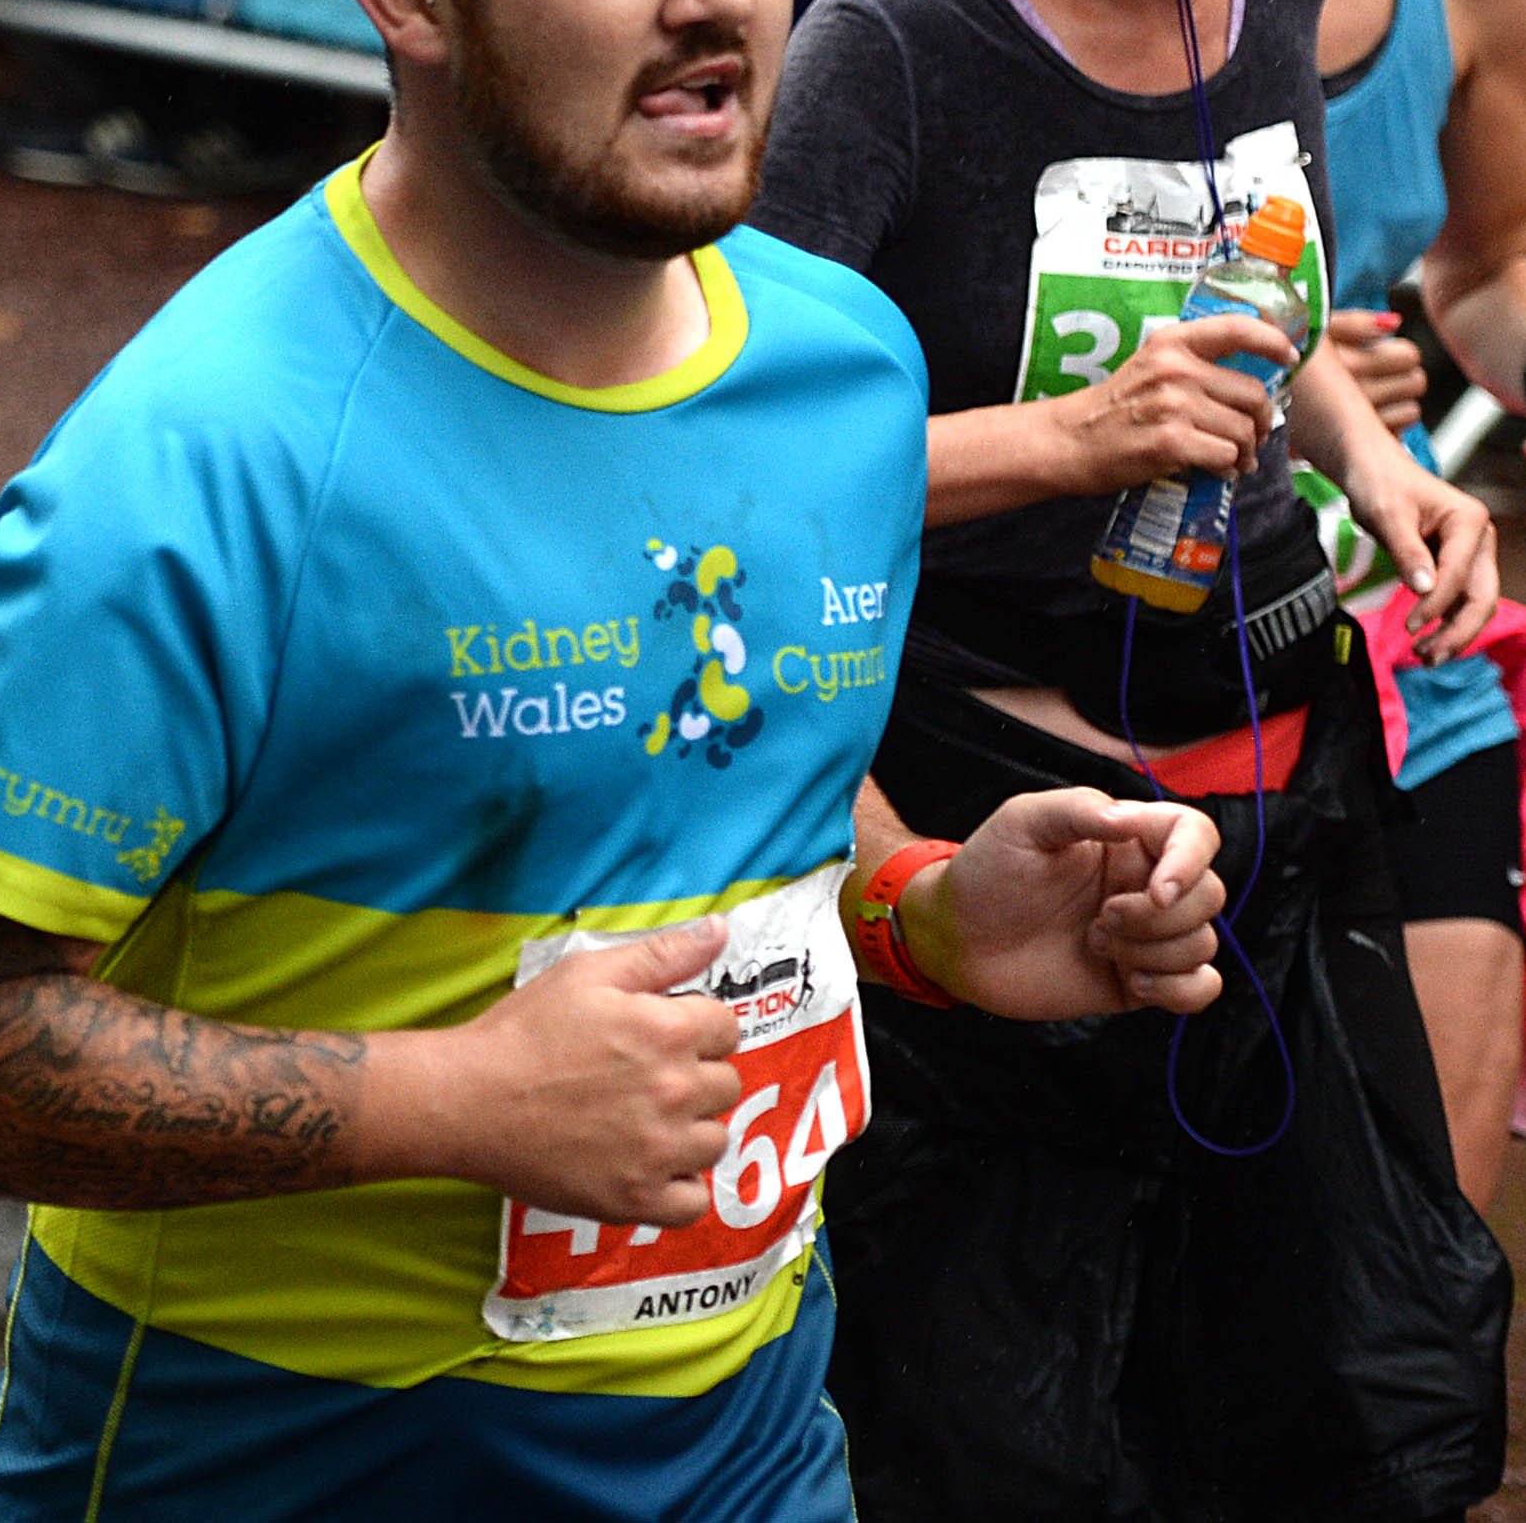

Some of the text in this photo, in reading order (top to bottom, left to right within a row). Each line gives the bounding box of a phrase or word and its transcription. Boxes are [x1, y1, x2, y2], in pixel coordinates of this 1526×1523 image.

[445, 617, 642, 678] Kidney
[451, 683, 627, 739] Wales
[755, 984, 799, 1019] 10K
[634, 1272, 758, 1321] ANTONY
